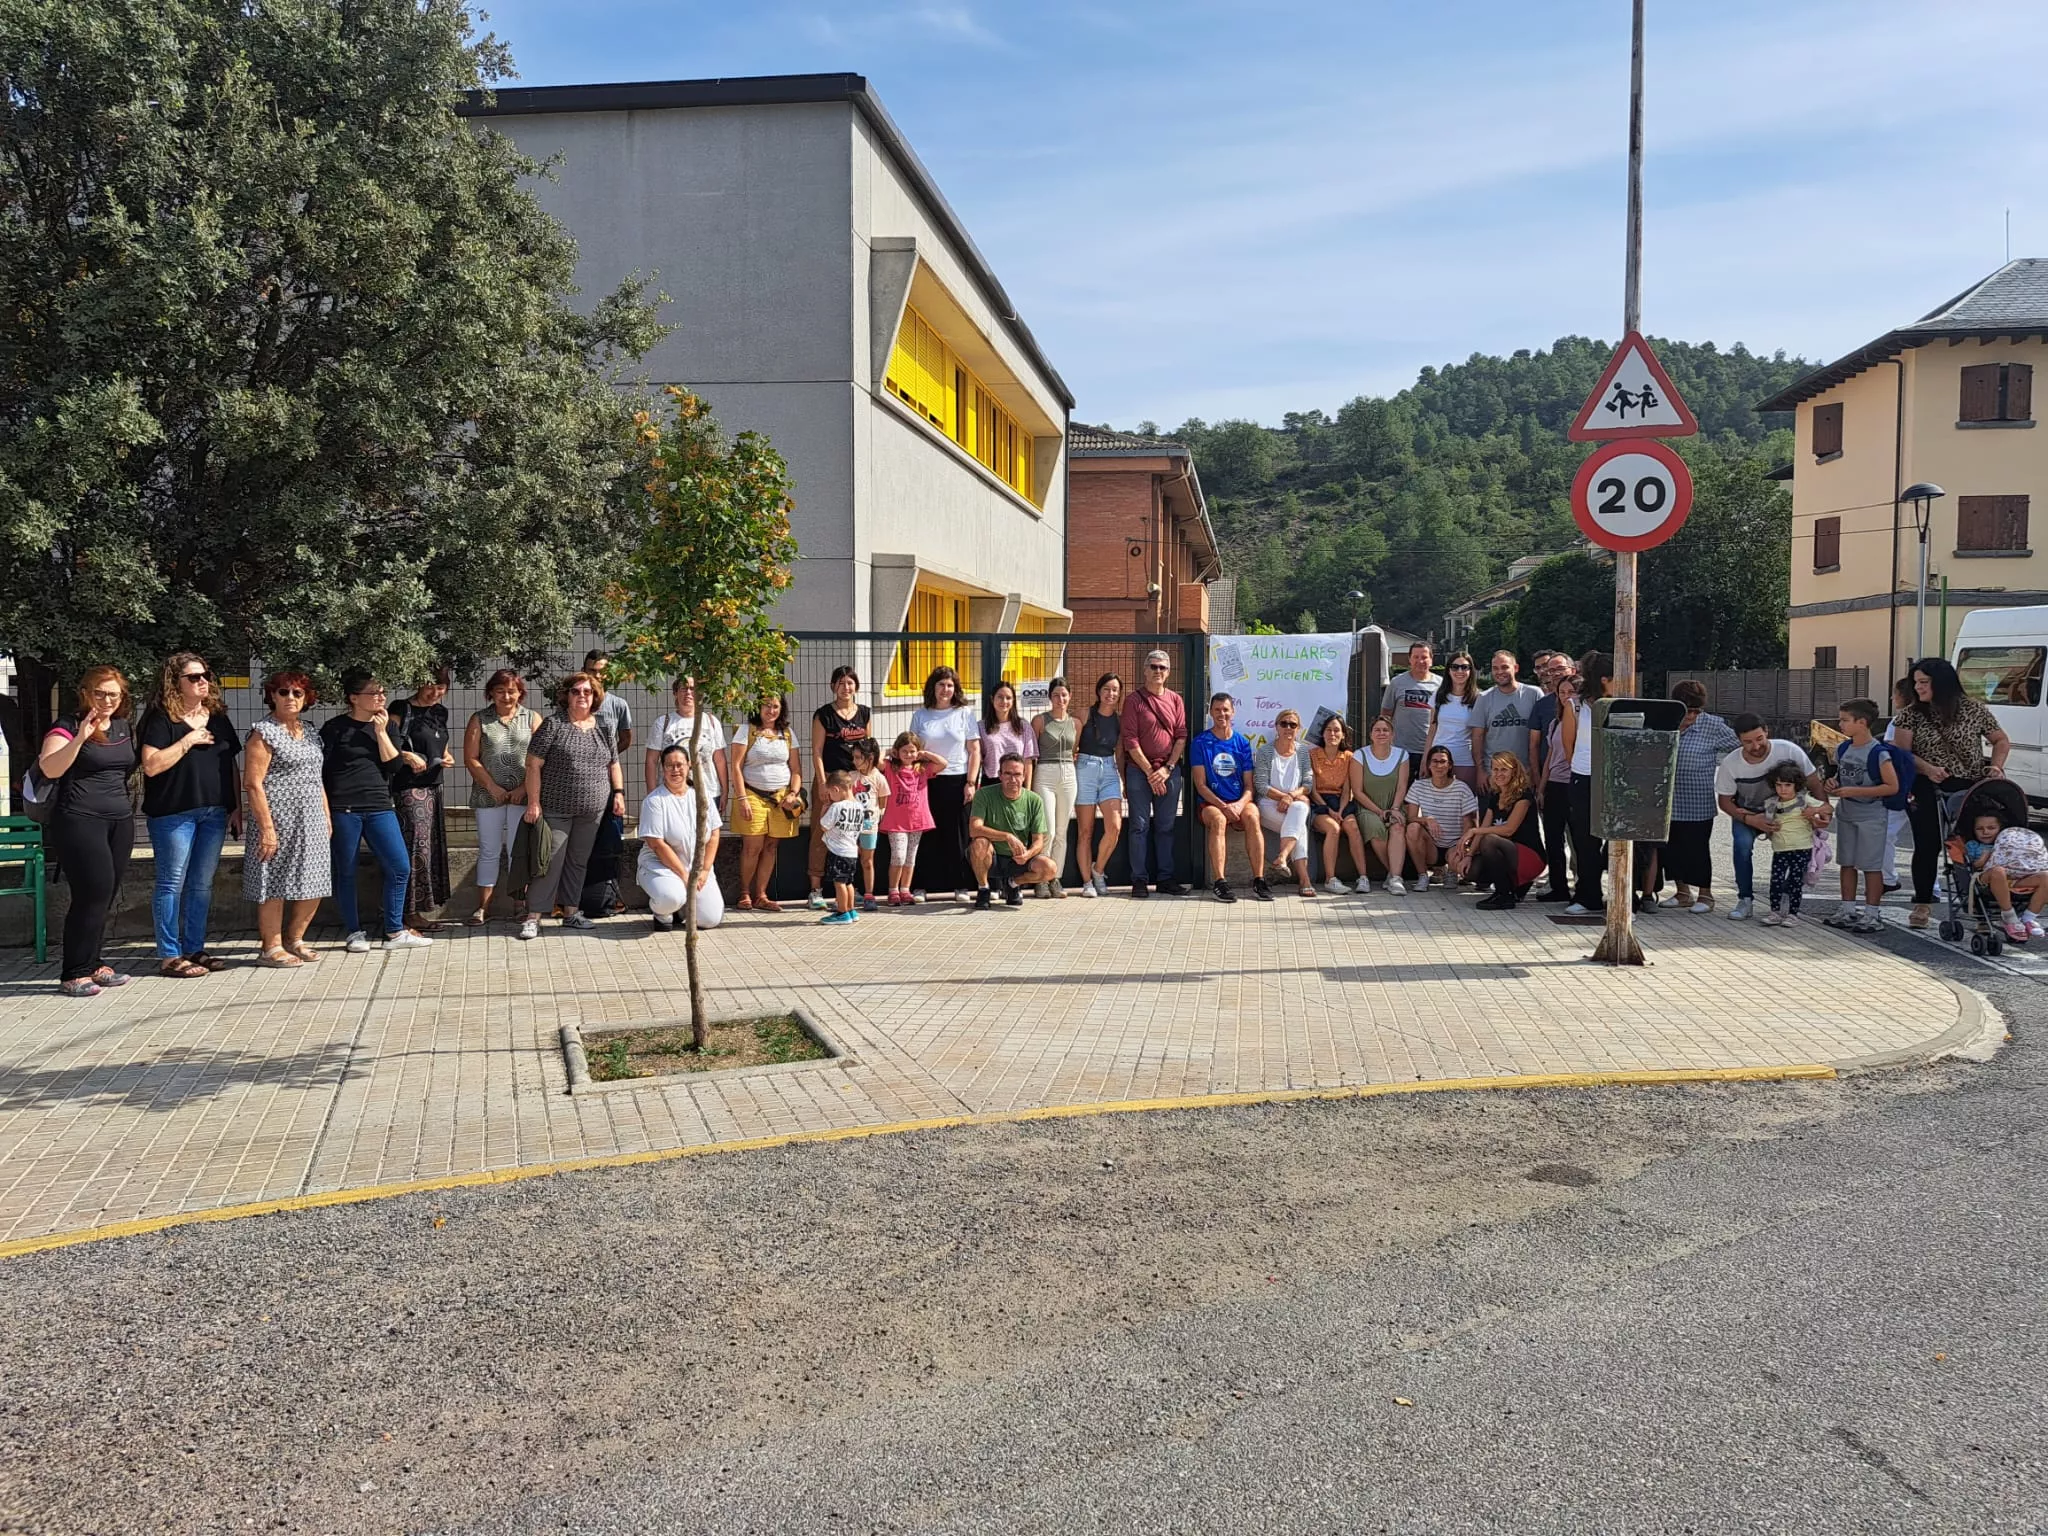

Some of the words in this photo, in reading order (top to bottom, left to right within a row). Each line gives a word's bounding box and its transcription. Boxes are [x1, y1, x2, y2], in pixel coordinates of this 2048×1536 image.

[1597, 476, 1666, 514] 20
[1256, 668, 1334, 682] SUFICIENTES
[1246, 719, 1276, 729] COLEG
[1243, 733, 1267, 749] YA
